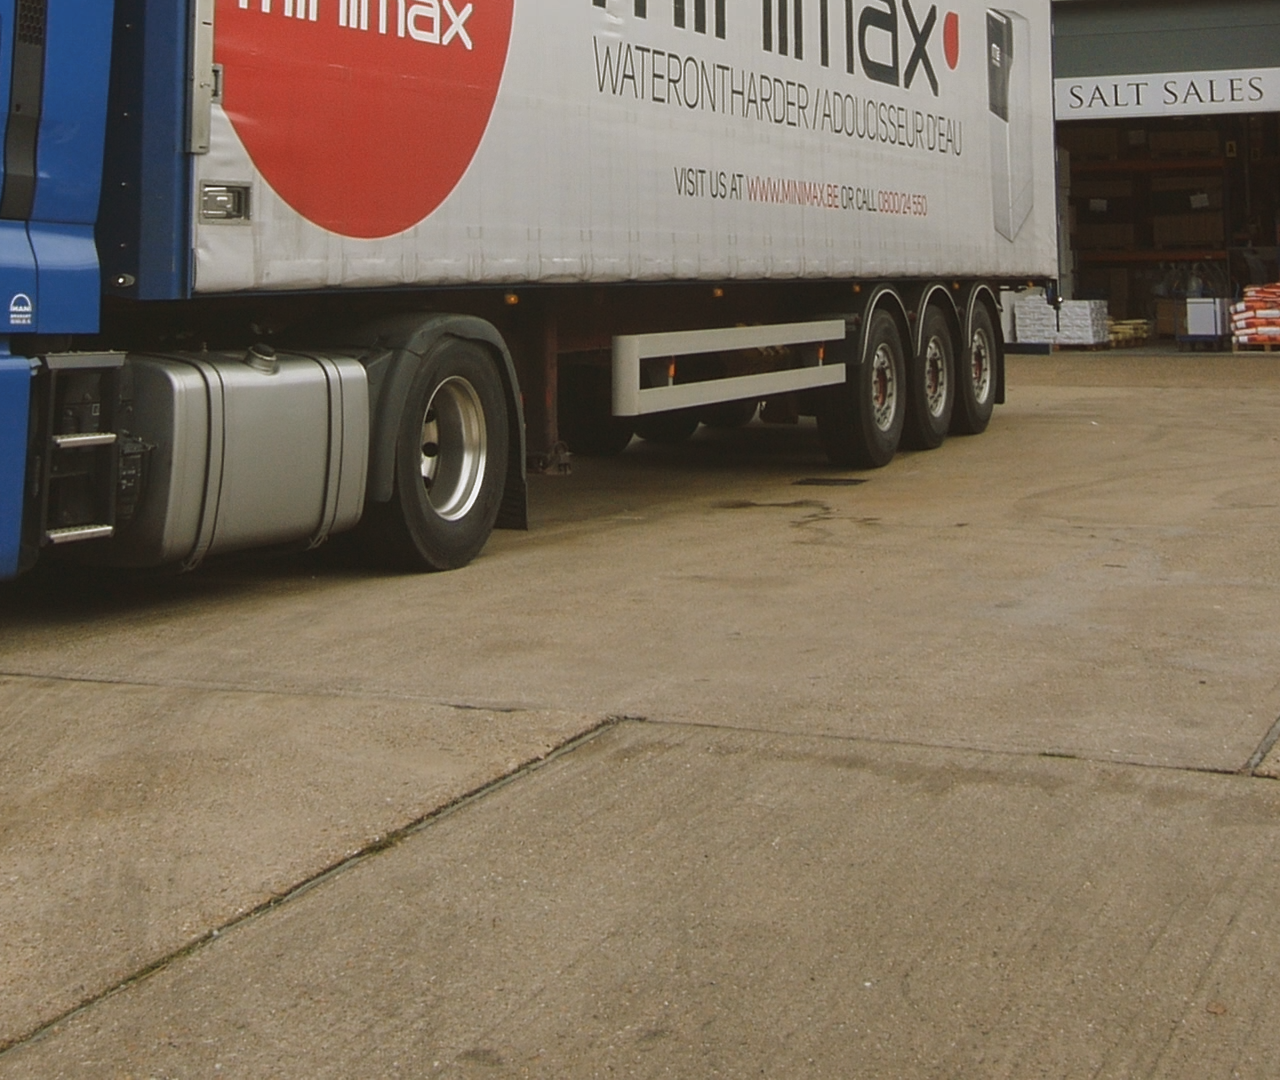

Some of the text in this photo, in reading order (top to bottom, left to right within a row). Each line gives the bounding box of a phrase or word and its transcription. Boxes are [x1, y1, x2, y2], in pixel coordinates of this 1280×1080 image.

[1069, 82, 1148, 109] SALT
[1162, 76, 1264, 106] SALES
[926, 113, 962, 157] D'EAU
[674, 166, 706, 197] VISIT
[709, 171, 727, 199] US
[730, 173, 744, 200] AT
[746, 175, 840, 209] WWW.MINIMAX.BE
[841, 185, 854, 210] OR
[855, 187, 877, 212] CALL
